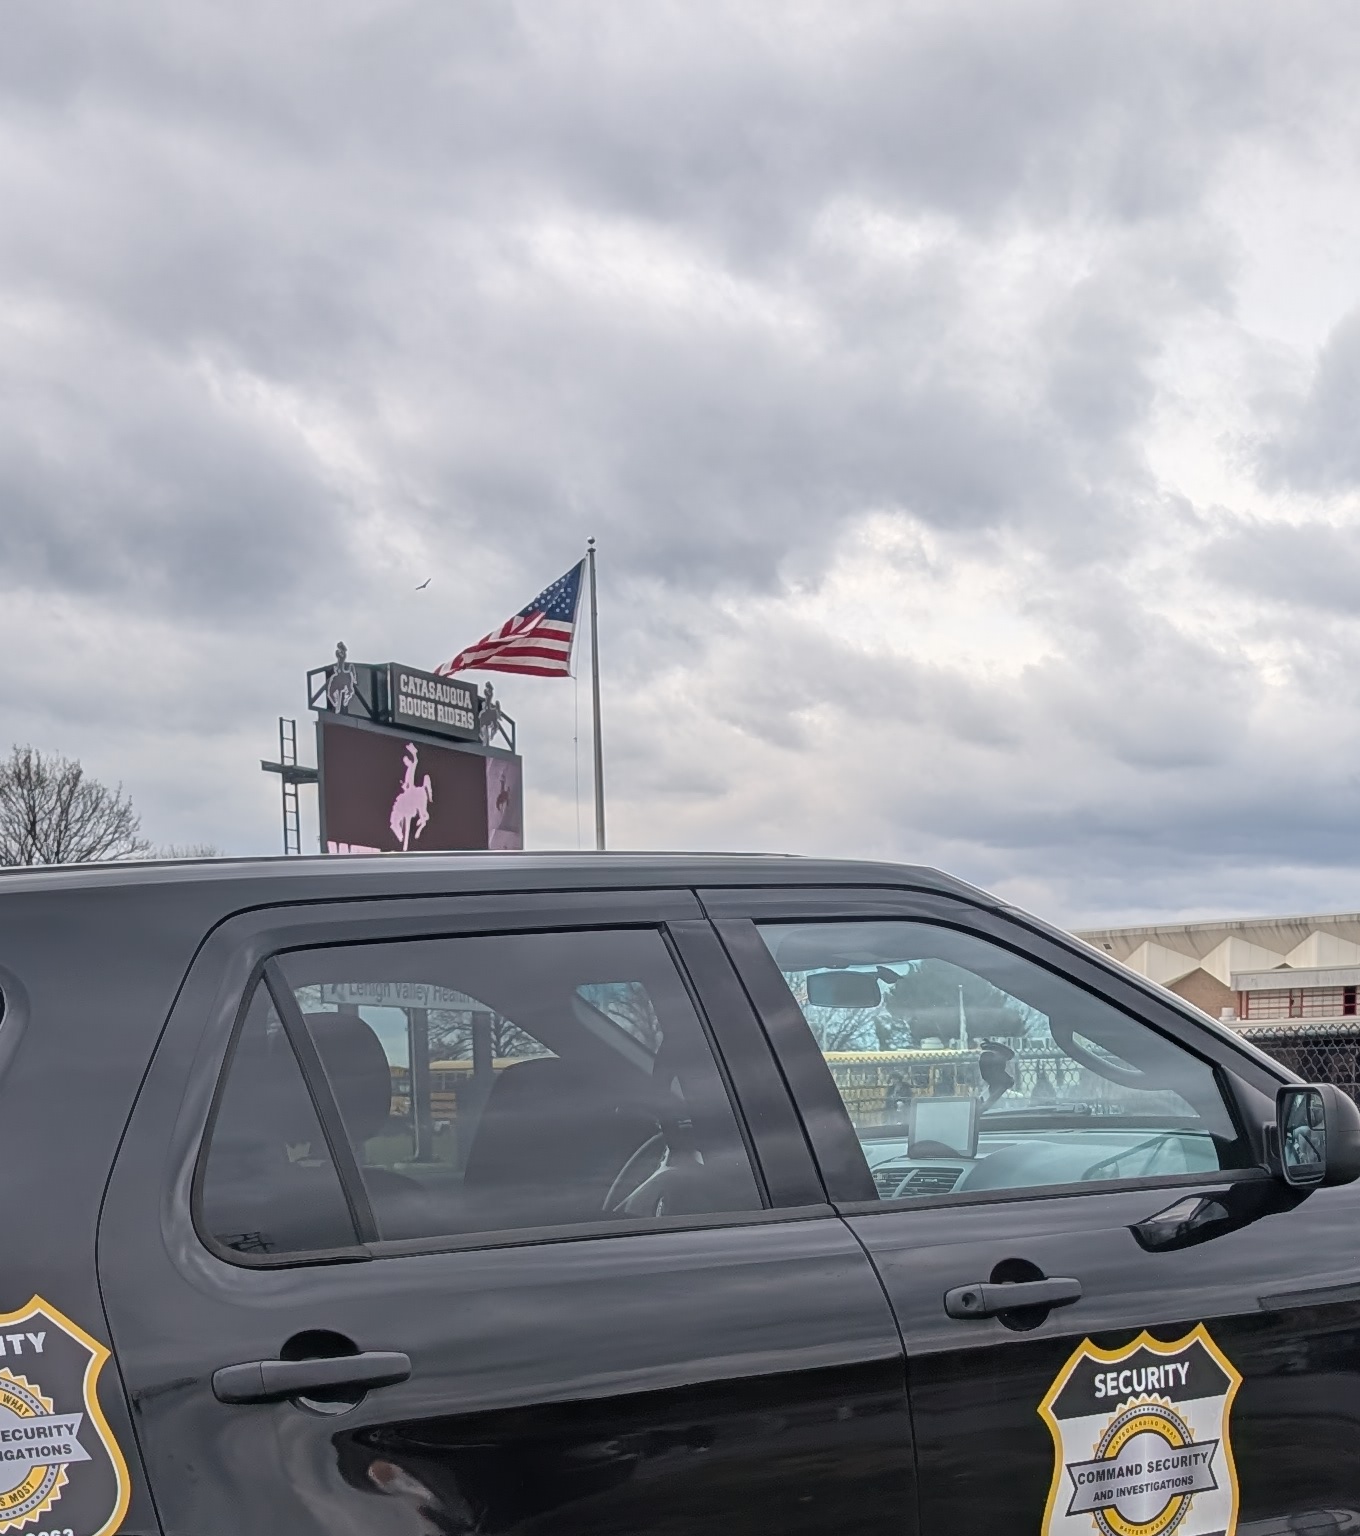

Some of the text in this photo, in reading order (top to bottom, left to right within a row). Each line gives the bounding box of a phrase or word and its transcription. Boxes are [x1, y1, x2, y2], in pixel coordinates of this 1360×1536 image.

[400, 674, 472, 709] CATASAUQUA
[399, 695, 475, 730] ROUGH RIDERS
[396, 983, 430, 1005] Valley
[1094, 1361, 1190, 1399] SECURITY
[2, 1393, 30, 1418] WHAT
[1077, 1452, 1209, 1486] COMMAND SECURITY
[9, 1480, 35, 1505] MOST
[1093, 1475, 1194, 1502] AND INVESTIGATIONS
